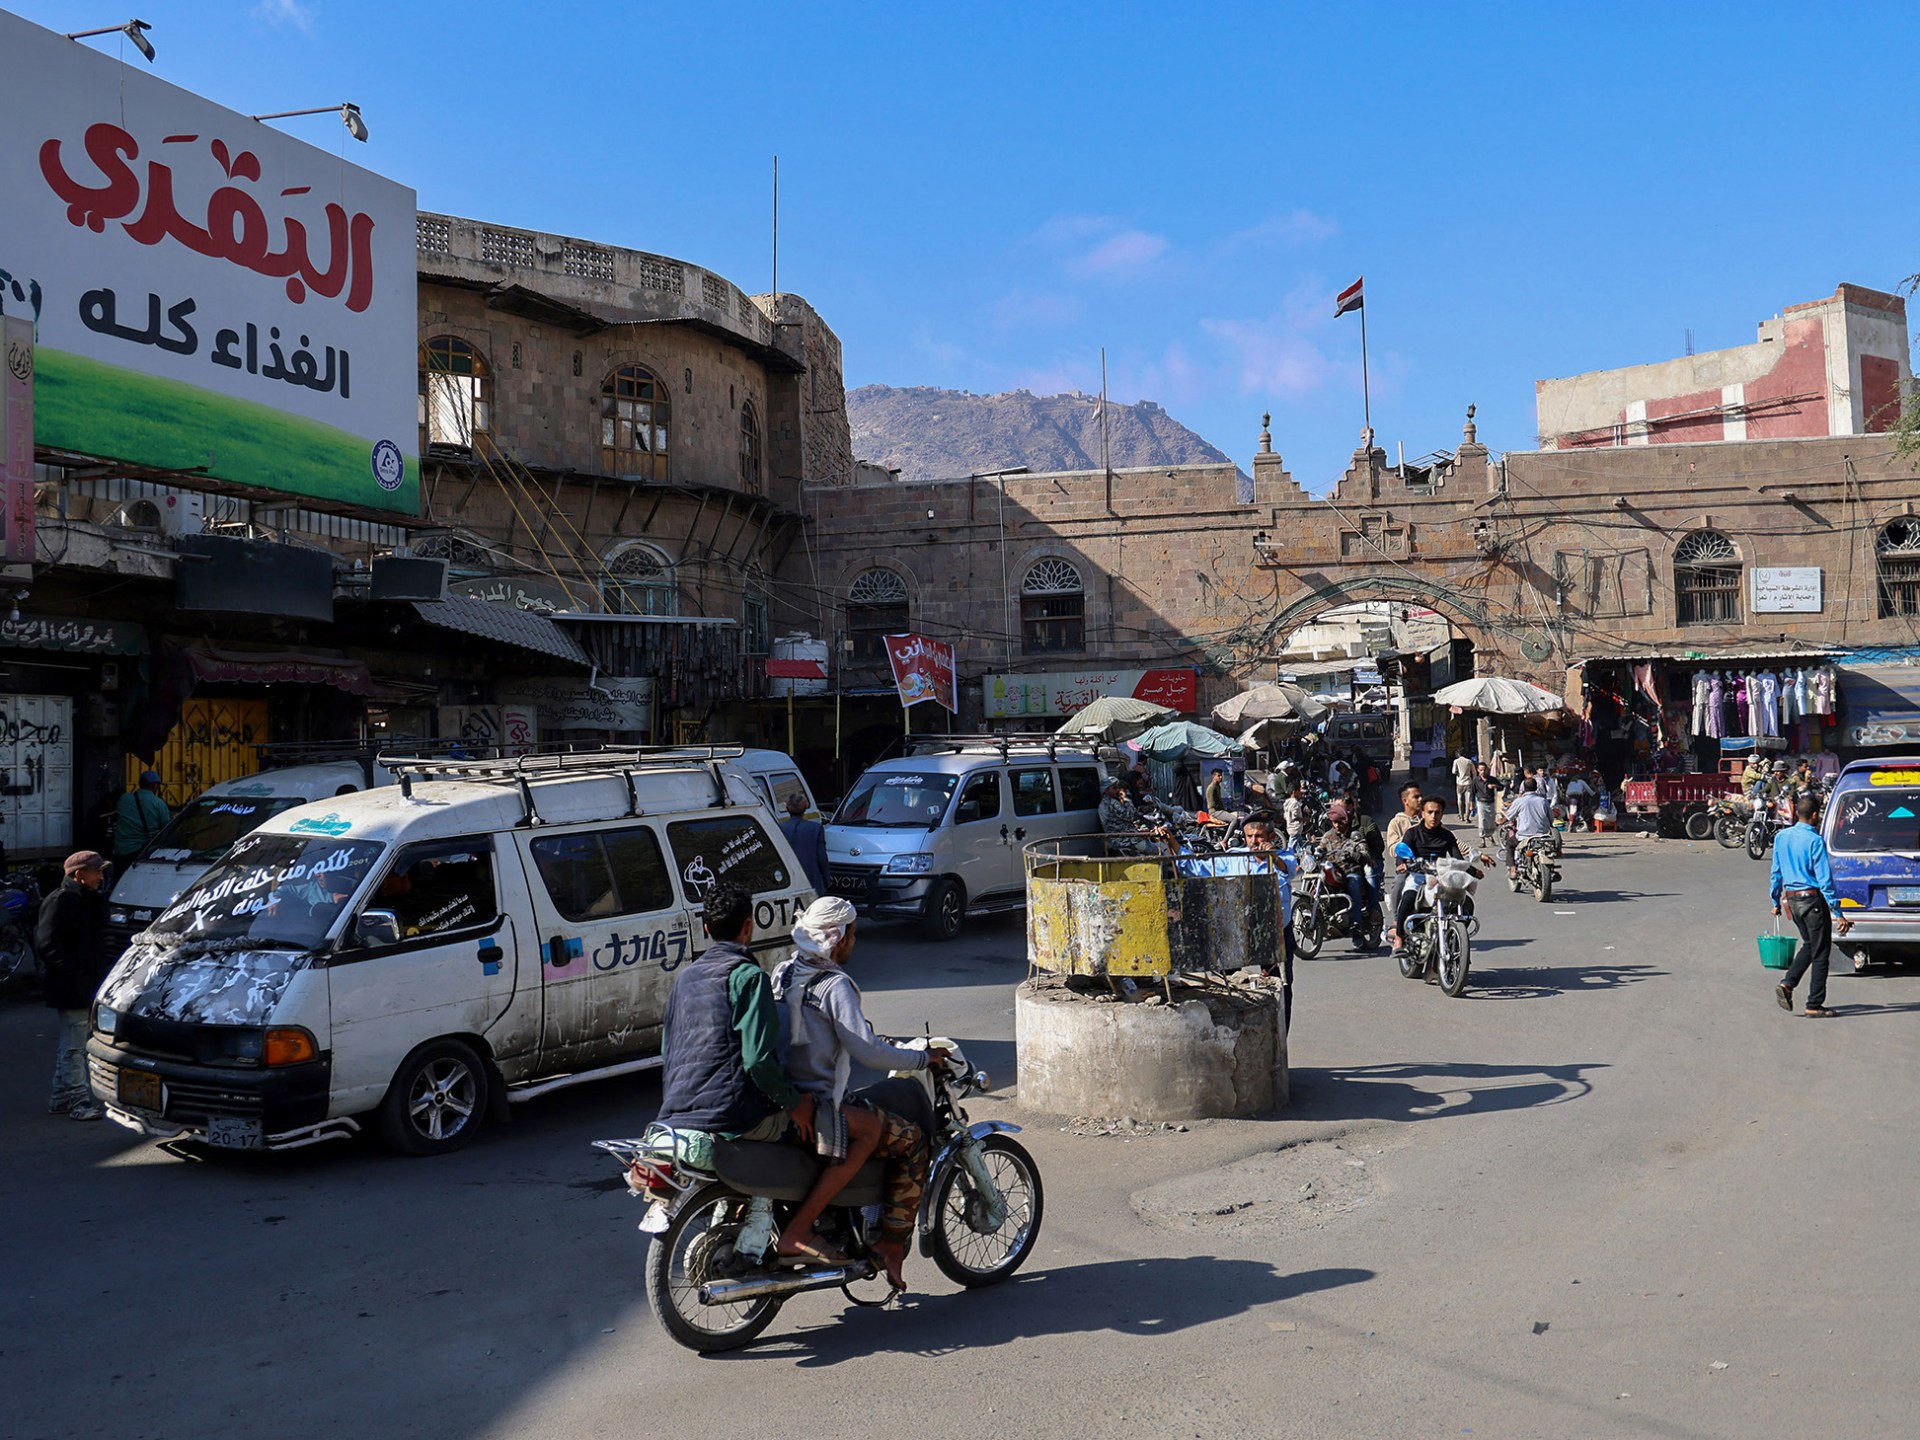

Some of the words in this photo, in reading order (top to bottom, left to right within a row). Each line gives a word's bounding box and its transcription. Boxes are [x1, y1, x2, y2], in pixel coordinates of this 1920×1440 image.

[78, 287, 199, 356] كله
[210, 321, 351, 400] الغذاء
[1106, 673, 1118, 685] كل
[1159, 673, 1187, 684] حلويات
[694, 896, 808, 940] TOTA
[592, 929, 688, 972] ナカムラ
[211, 1131, 258, 1147] 20-17
